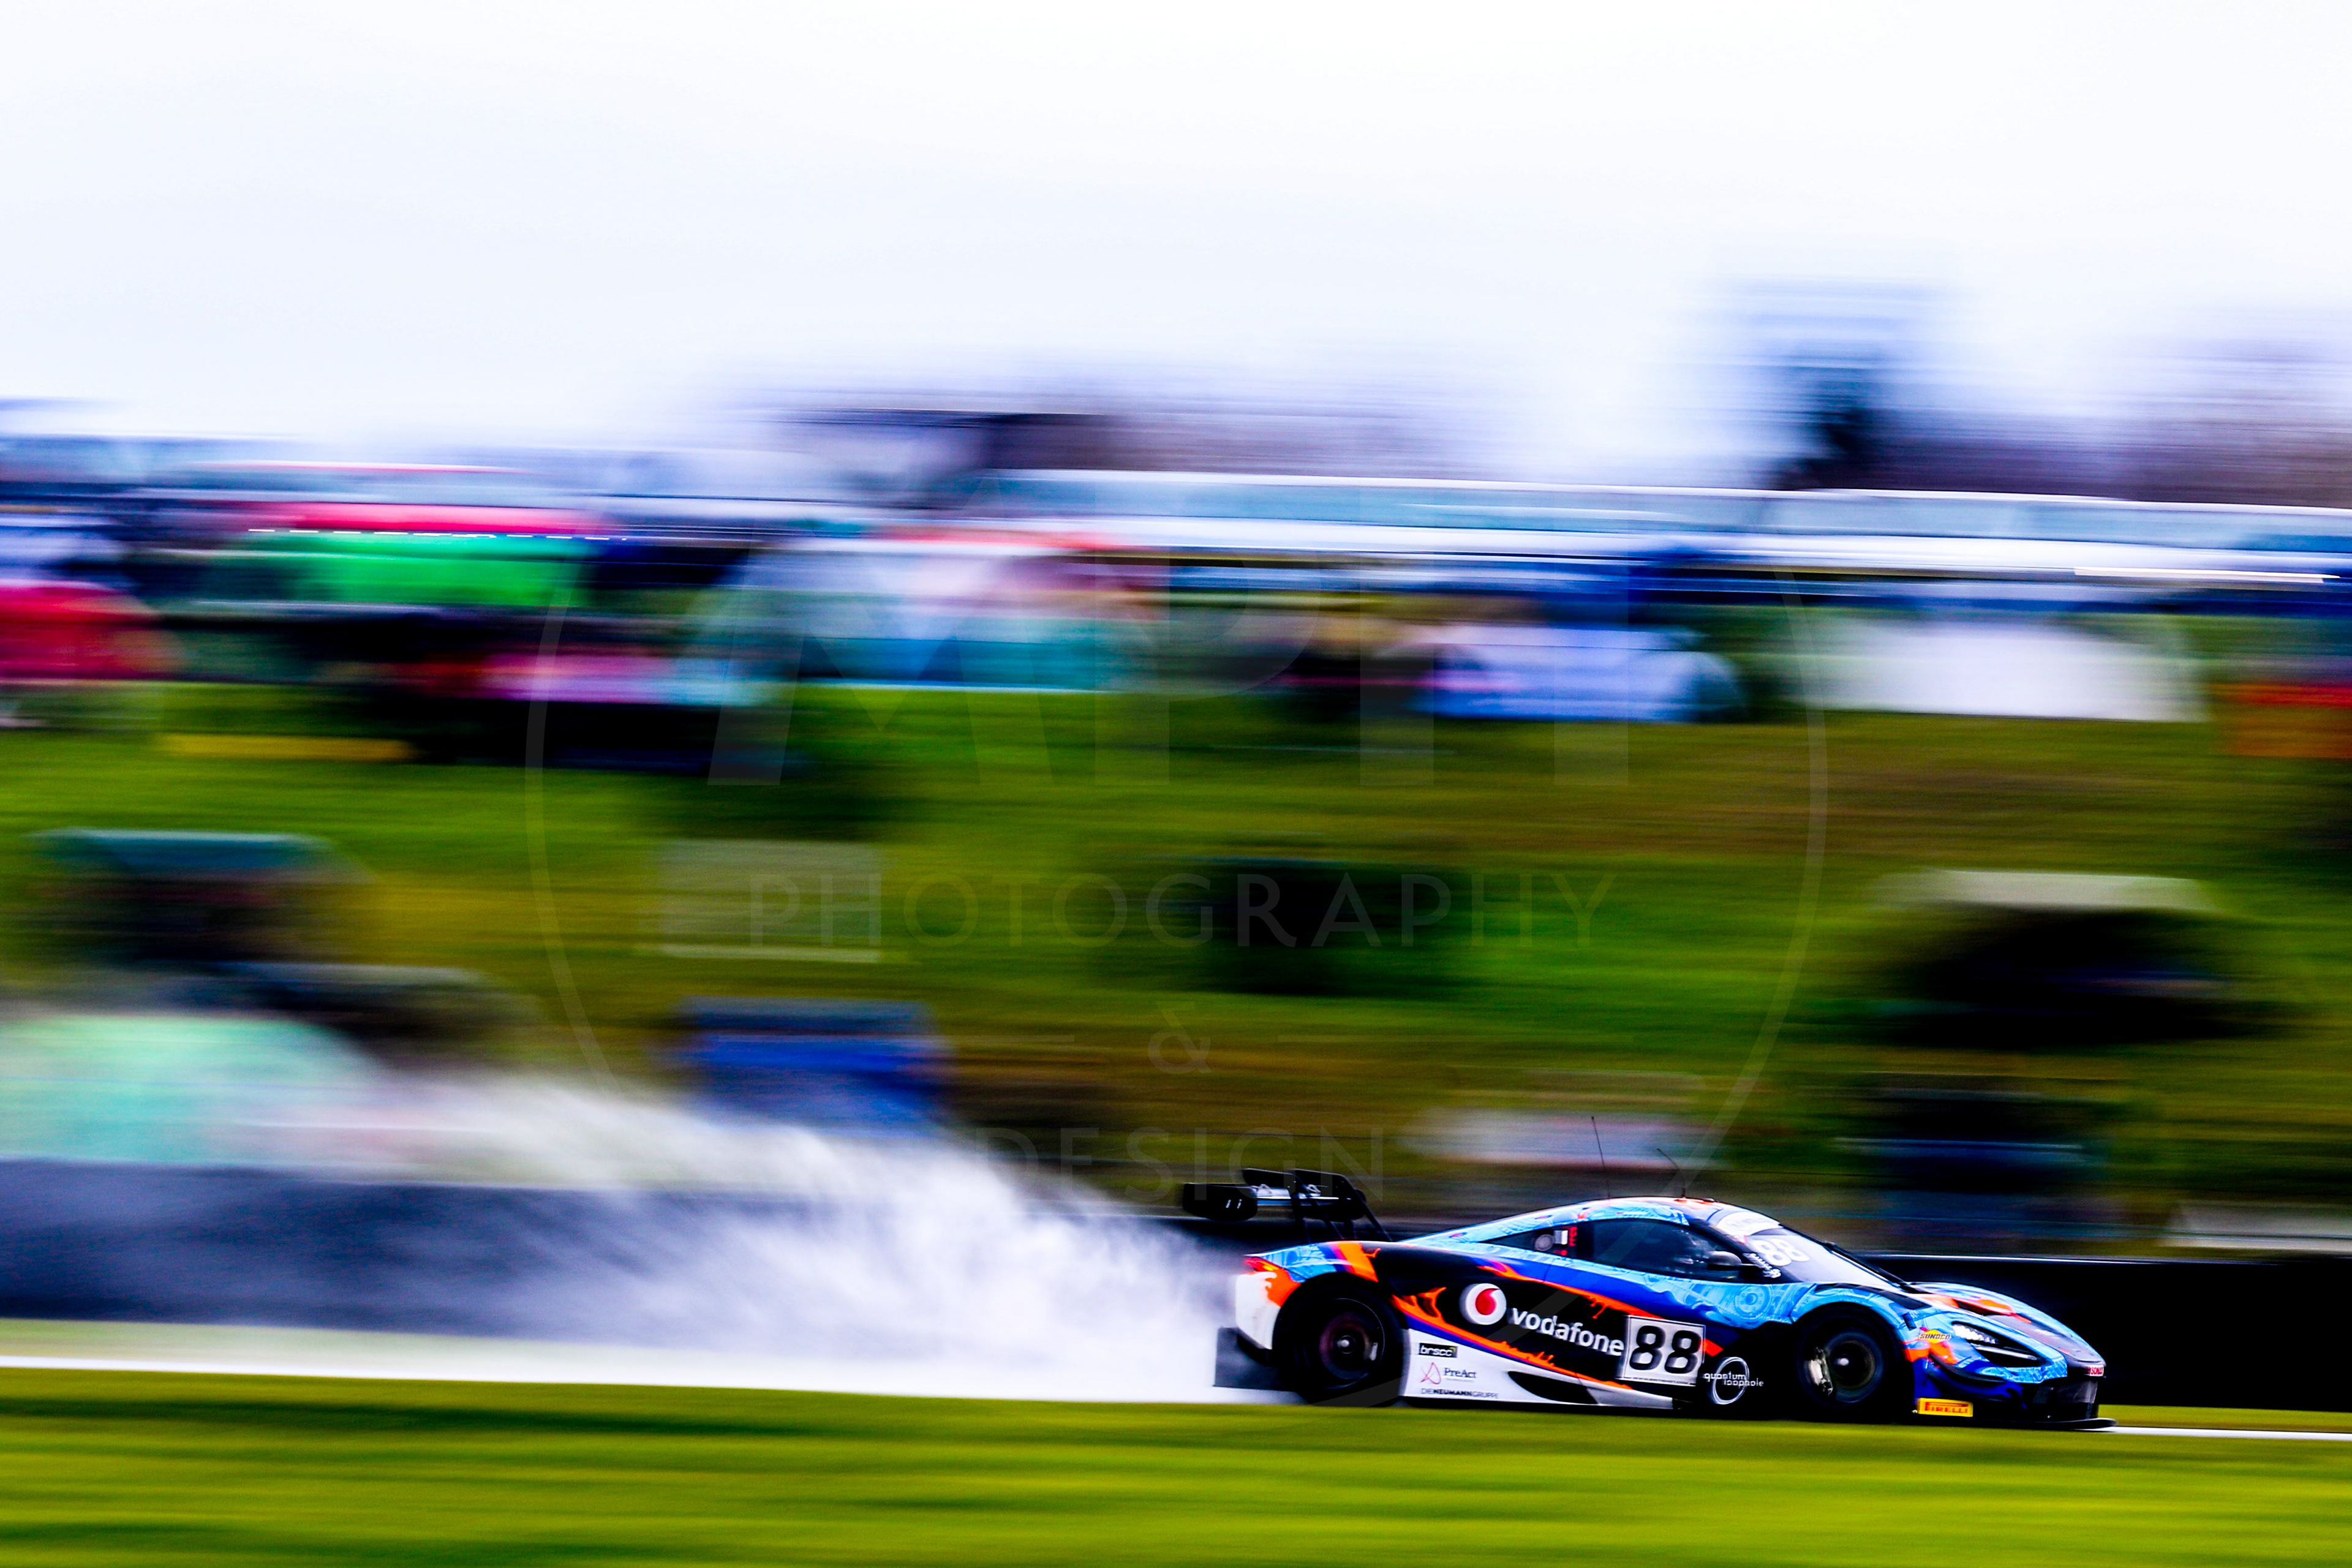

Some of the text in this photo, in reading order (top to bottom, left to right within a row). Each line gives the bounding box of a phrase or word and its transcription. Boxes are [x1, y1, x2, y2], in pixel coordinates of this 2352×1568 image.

[1750, 1238, 1810, 1266] 88
[1512, 1308, 1624, 1356] vodafone
[1420, 1344, 1453, 1357] brscc
[1629, 1325, 1702, 1374] 88
[1444, 1367, 1477, 1378] PreAct
[1703, 1371, 1747, 1382] quantum
[1724, 1378, 1764, 1389] loophole
[1925, 1401, 1969, 1414] PIRELLI
